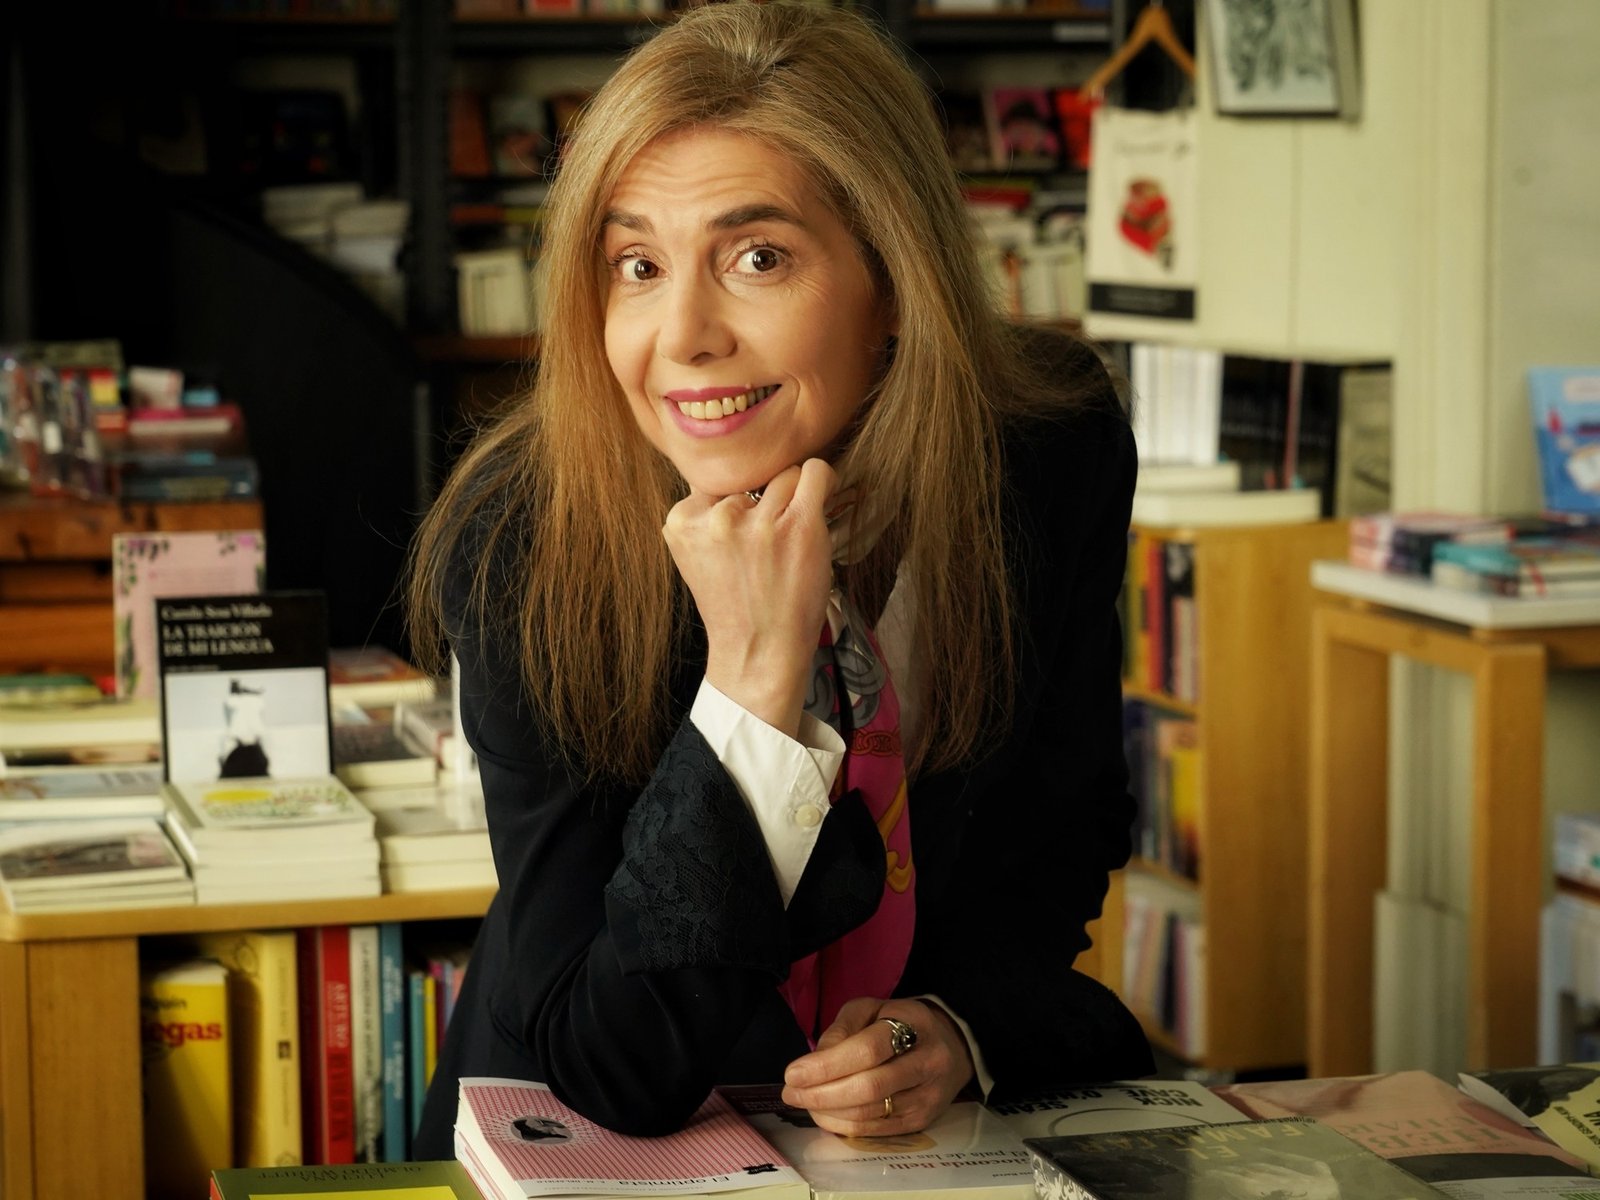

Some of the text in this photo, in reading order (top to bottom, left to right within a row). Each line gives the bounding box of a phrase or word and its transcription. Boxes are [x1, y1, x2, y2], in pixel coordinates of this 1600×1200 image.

[163, 624, 185, 640] LA
[164, 638, 274, 657] DE MI LENGUA
[143, 1021, 222, 1048] egas
[1120, 1088, 1203, 1107] NICK CAVE
[917, 1153, 940, 1161] las
[1176, 1146, 1241, 1160] EL
[889, 1162, 936, 1170] Belli
[618, 1175, 730, 1187] El optimista
